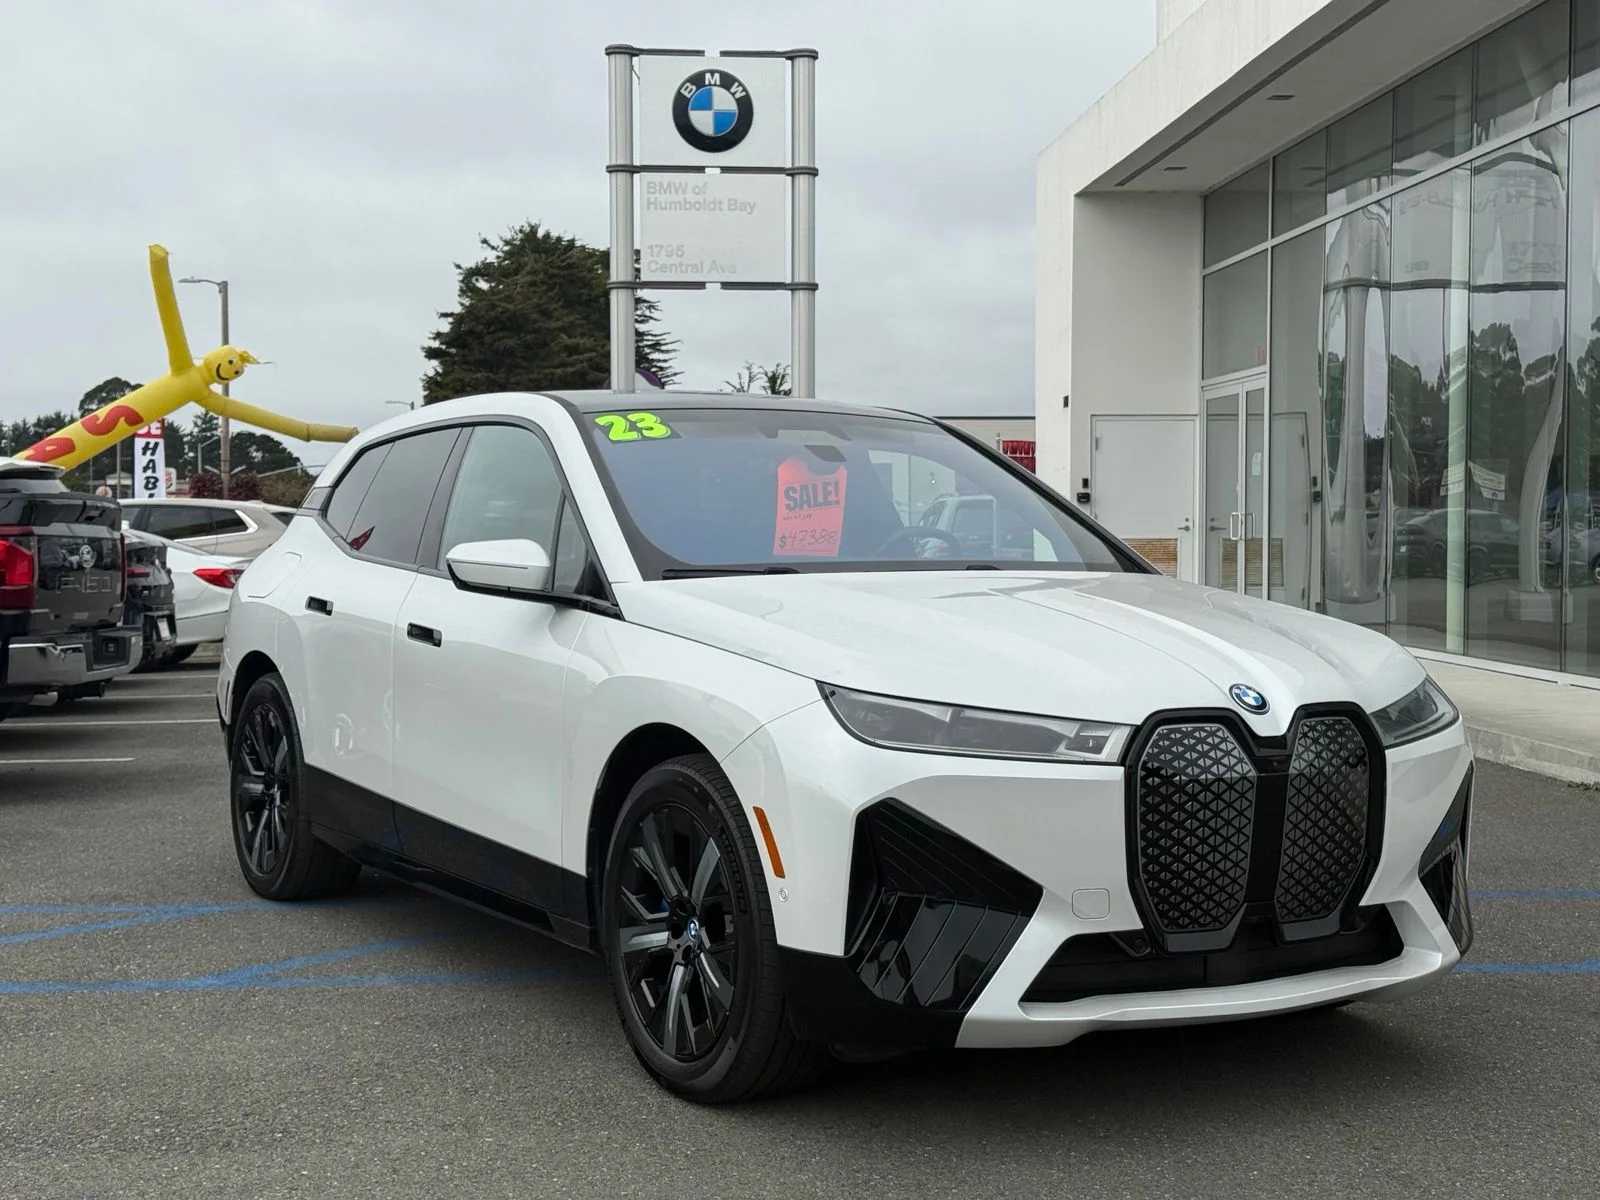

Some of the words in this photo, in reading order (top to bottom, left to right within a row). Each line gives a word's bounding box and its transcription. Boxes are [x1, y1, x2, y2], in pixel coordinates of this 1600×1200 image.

[680, 72, 746, 98] BMW
[646, 181, 689, 195] BMW
[692, 181, 708, 195] of
[646, 198, 724, 212] Humboldt
[727, 198, 757, 215] Bay
[647, 244, 685, 258] 1795
[647, 259, 704, 274] Central
[594, 412, 672, 441] 23
[783, 480, 841, 513] SALE!
